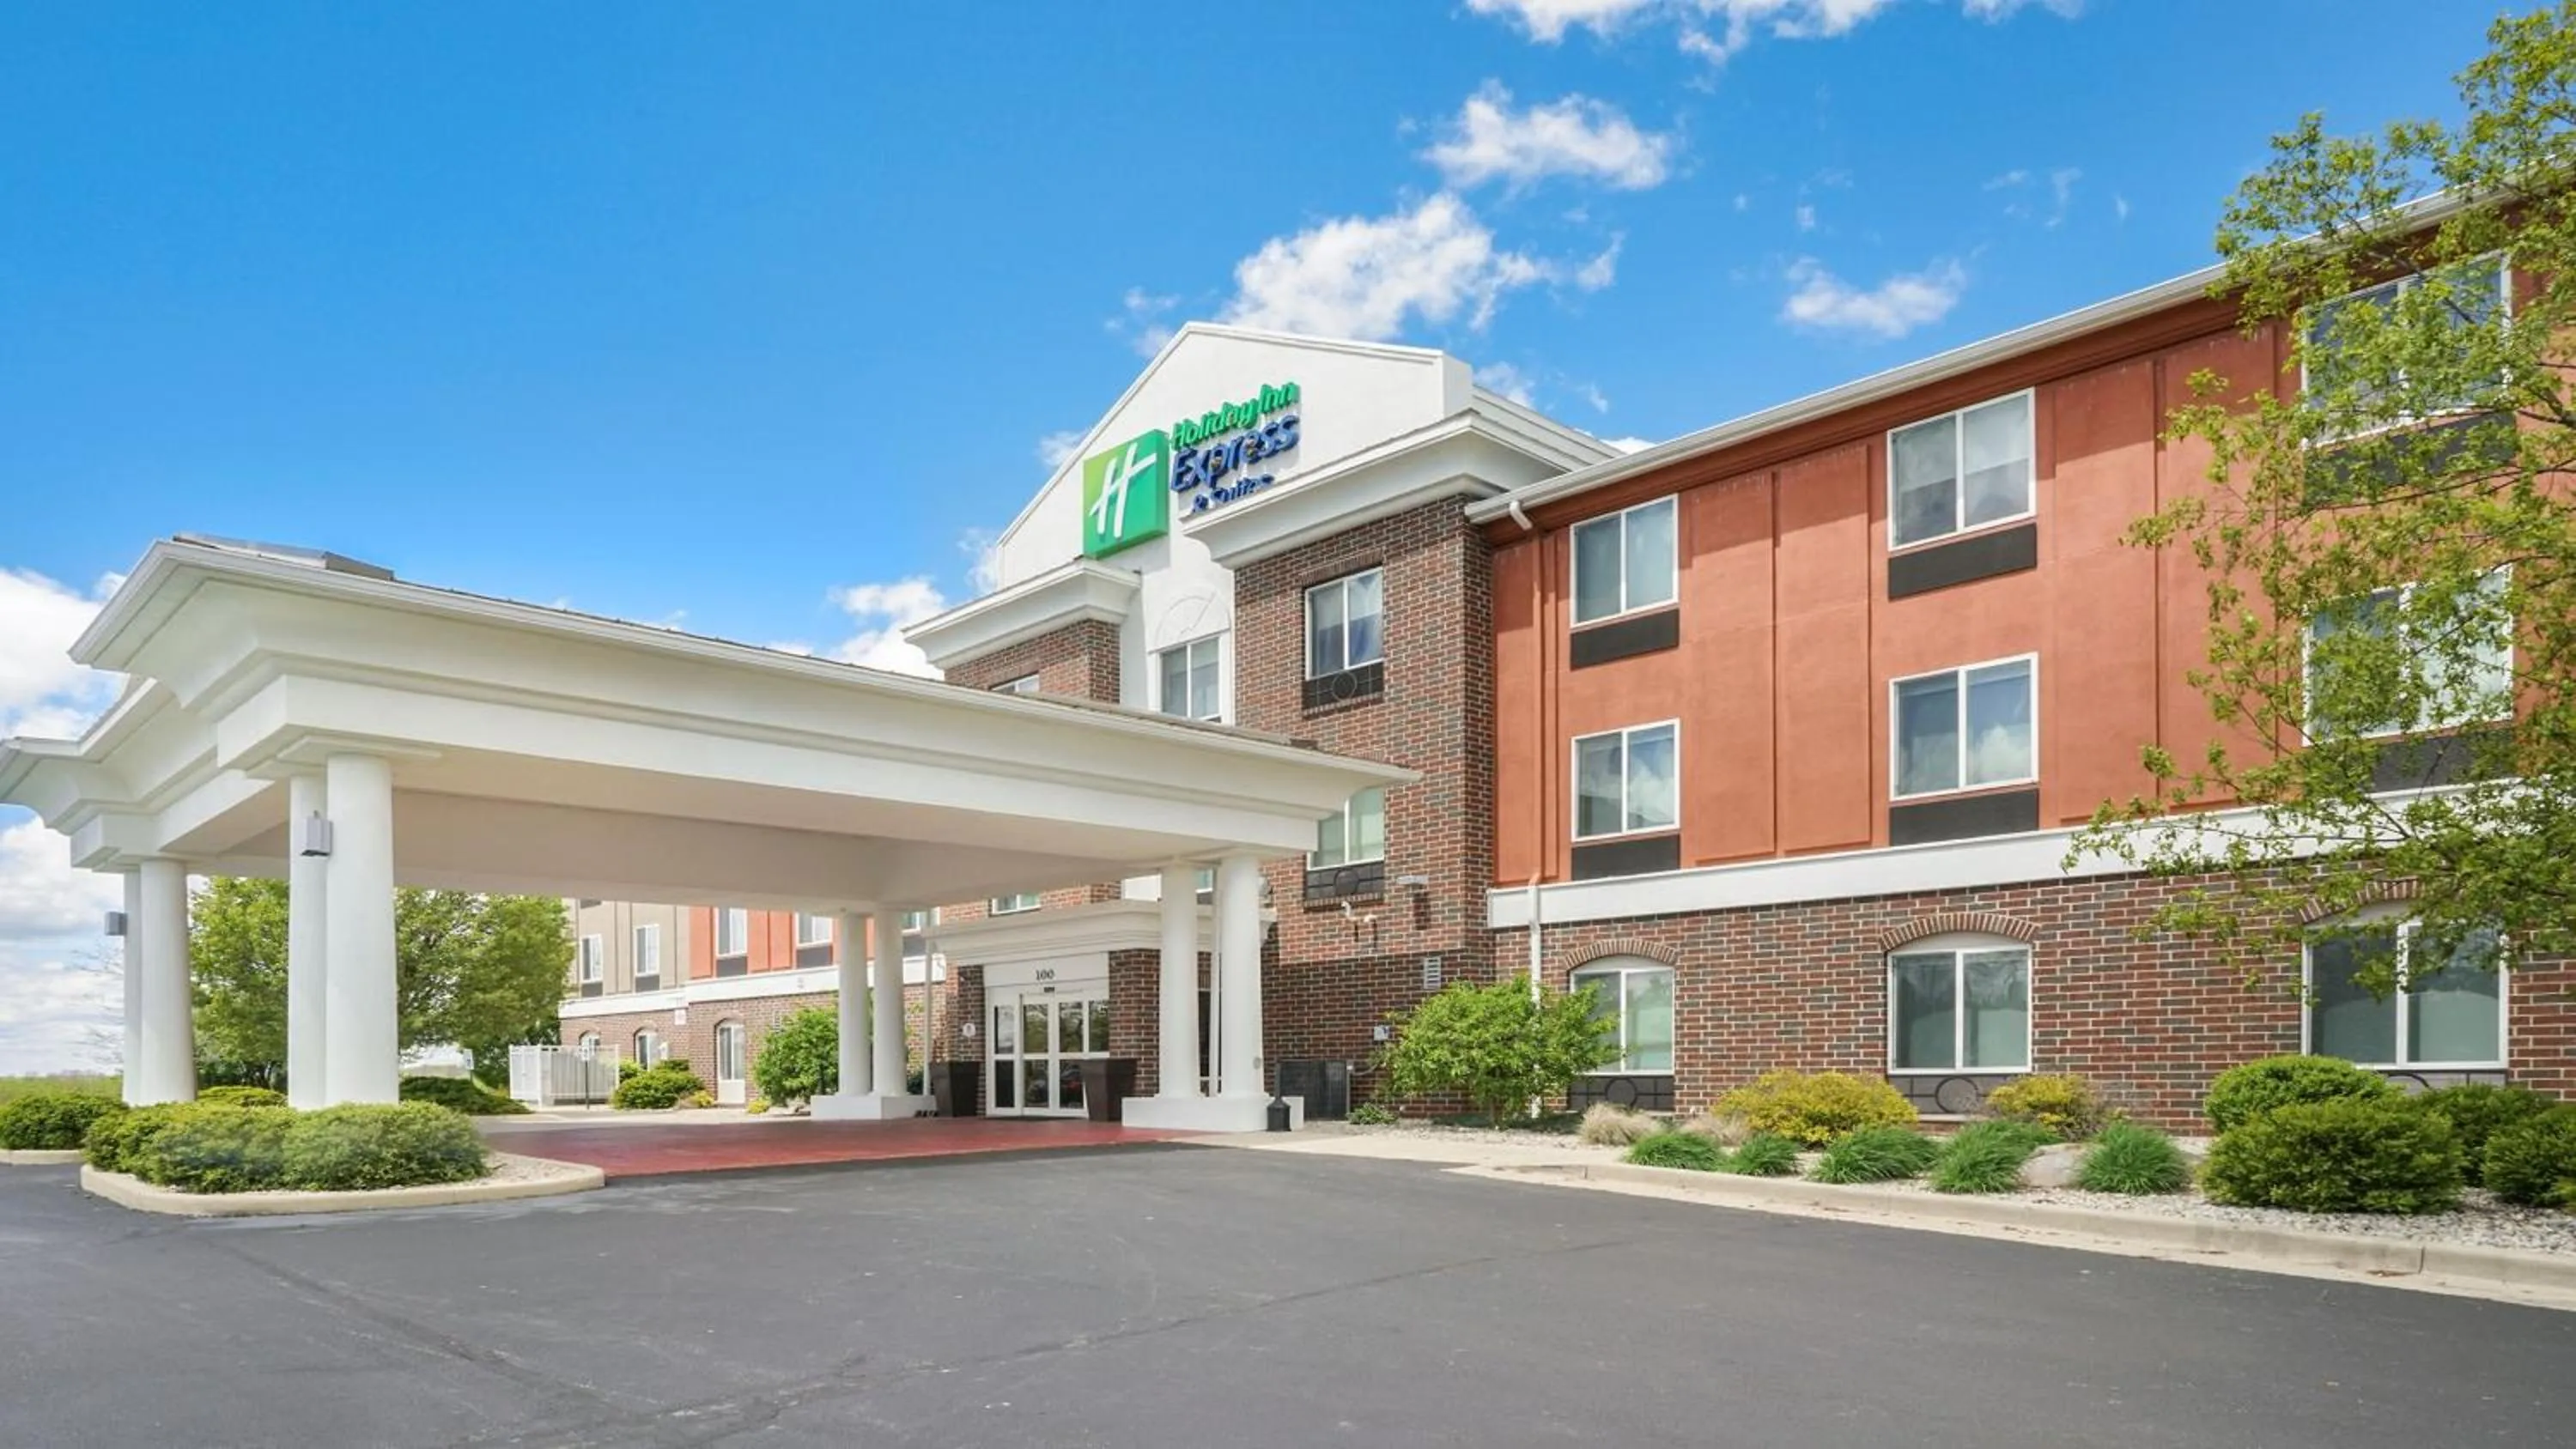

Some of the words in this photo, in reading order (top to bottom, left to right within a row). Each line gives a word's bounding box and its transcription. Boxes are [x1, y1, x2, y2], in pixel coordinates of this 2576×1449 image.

[1171, 398, 1260, 452] Holiday
[1258, 383, 1299, 415] Inn
[1170, 415, 1300, 493] Express
[1036, 969, 1054, 980] 100
